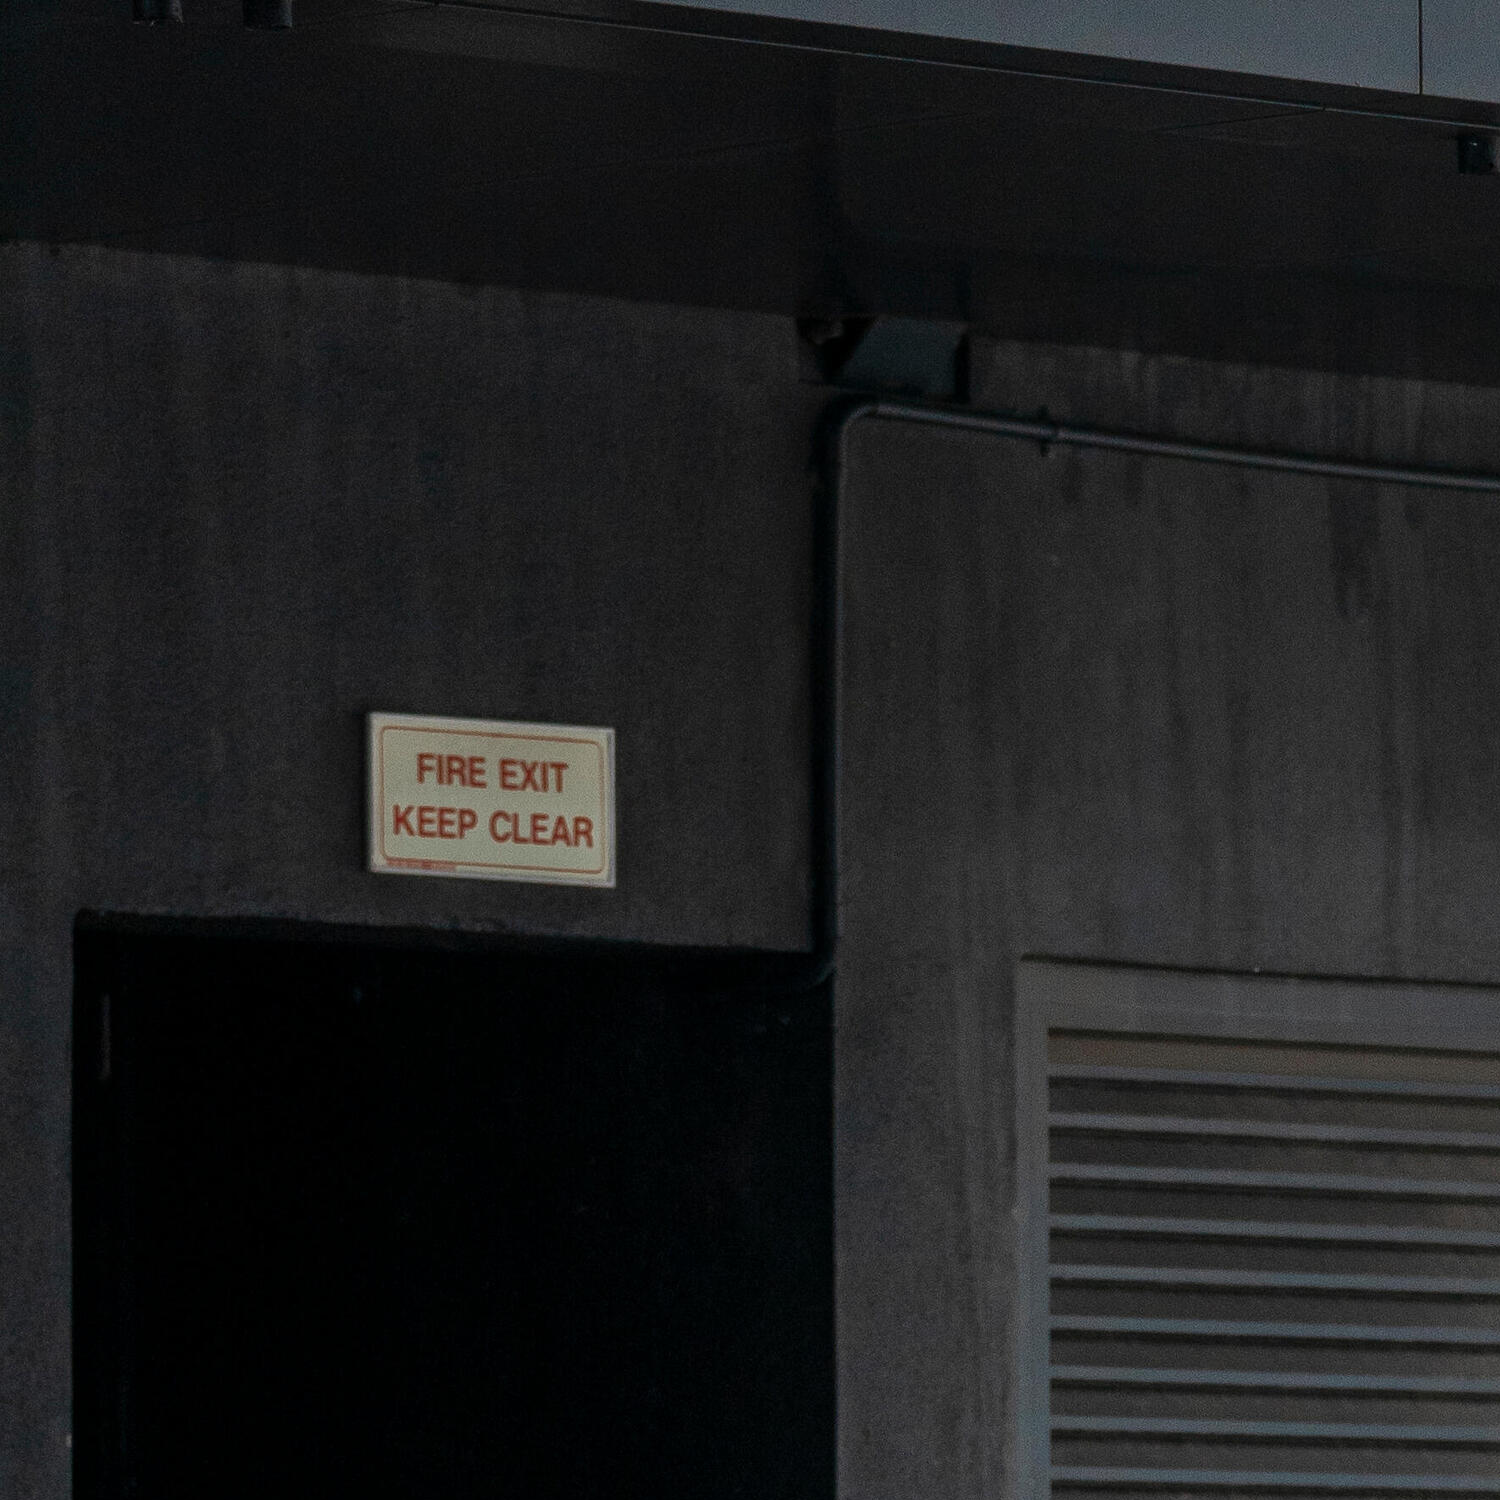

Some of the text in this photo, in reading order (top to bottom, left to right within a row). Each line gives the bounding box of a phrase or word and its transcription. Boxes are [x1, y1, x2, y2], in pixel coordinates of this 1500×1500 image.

[416, 753, 569, 793] FIRE EXIT
[392, 804, 594, 848] KEEP CLEAR
